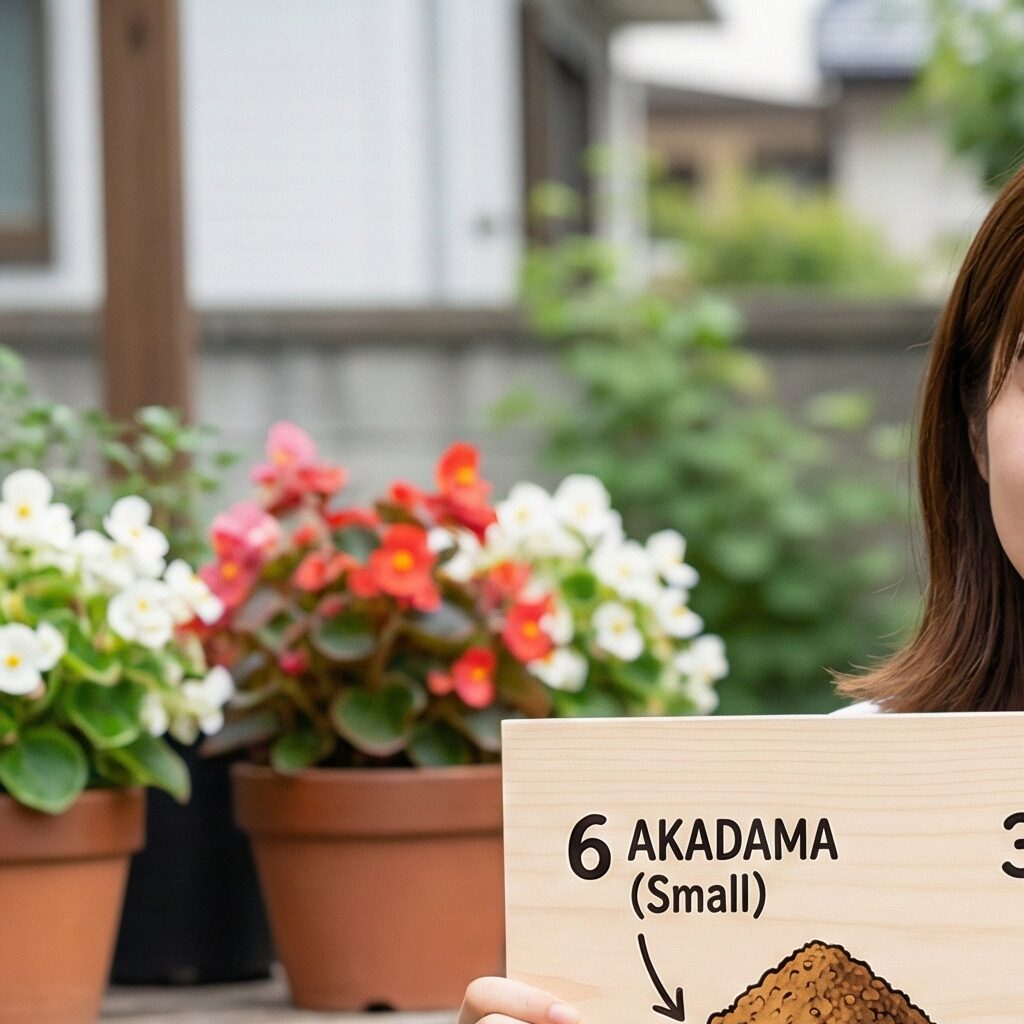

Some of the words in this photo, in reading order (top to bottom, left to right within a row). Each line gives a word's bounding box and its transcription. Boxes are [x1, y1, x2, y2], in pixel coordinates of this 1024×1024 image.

[567, 812, 613, 882] 6
[627, 817, 839, 863] AKADAMA
[630, 869, 767, 921] (Small)
